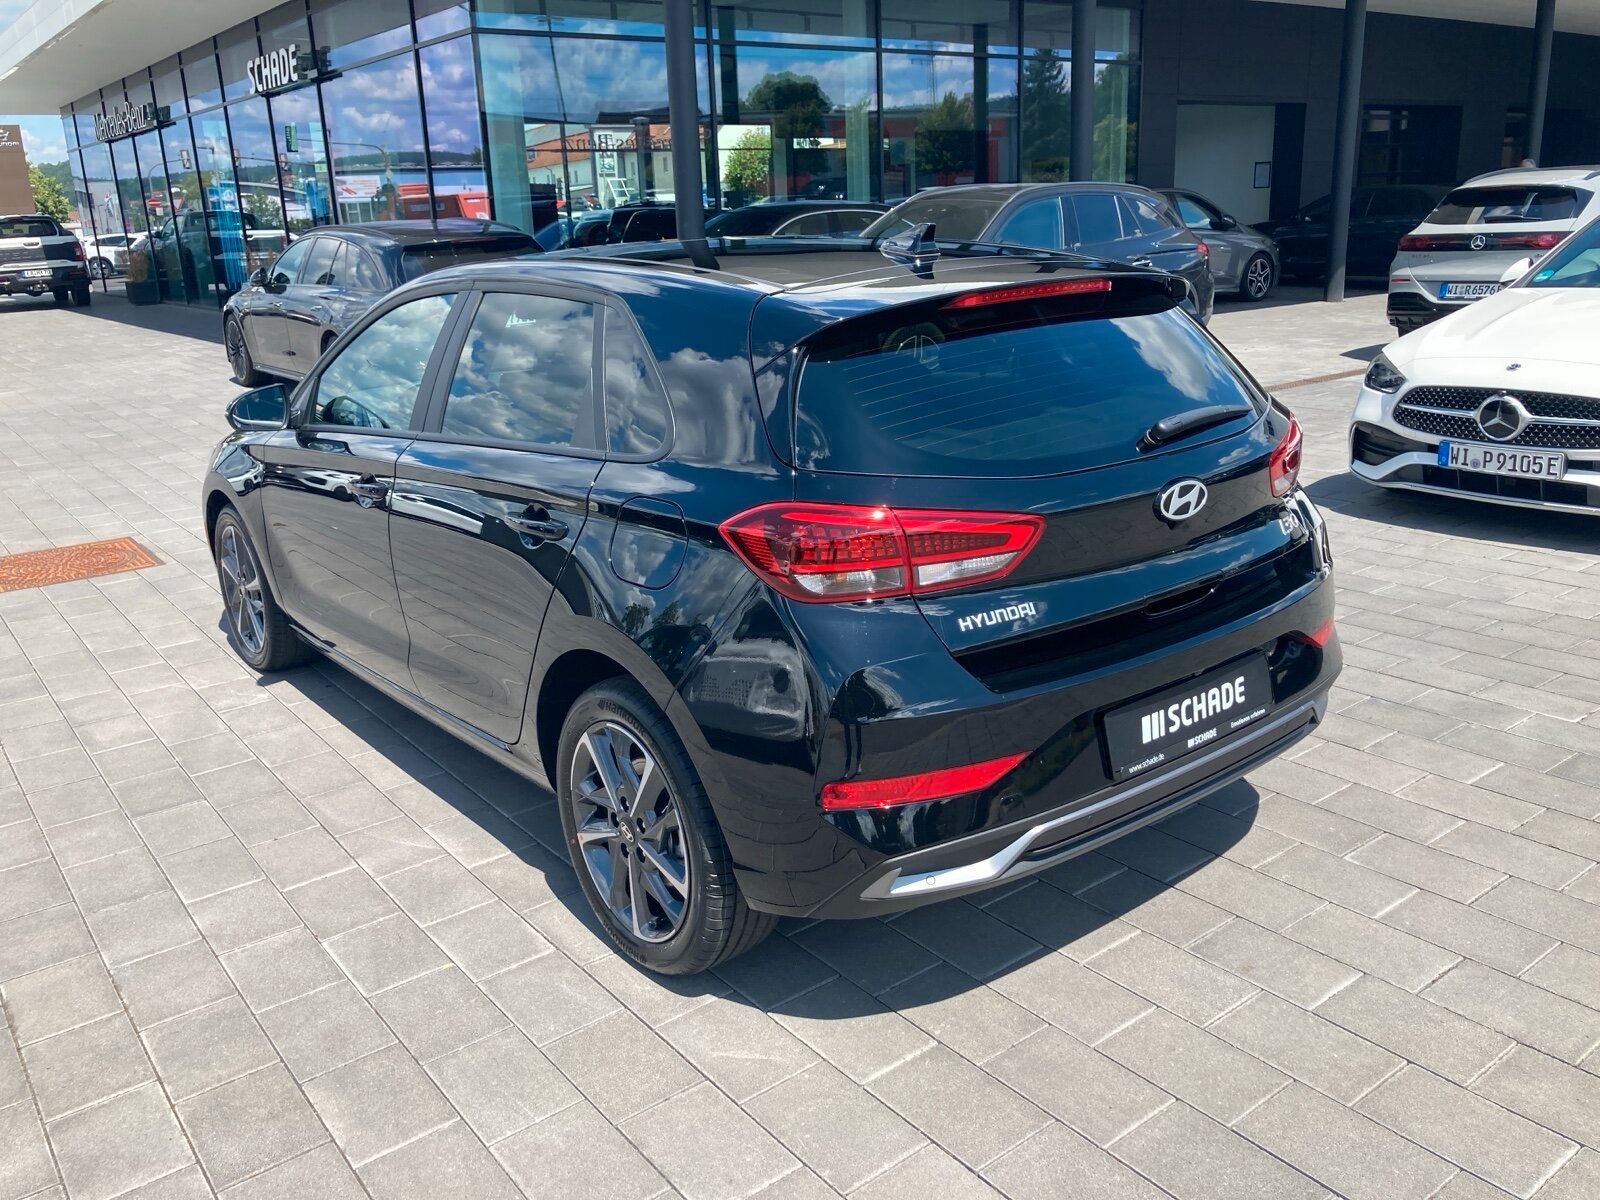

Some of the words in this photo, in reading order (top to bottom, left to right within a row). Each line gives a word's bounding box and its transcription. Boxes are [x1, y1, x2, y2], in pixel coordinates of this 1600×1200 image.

[247, 44, 298, 94] SCHADE
[96, 101, 147, 140] Mercedes-Benz
[1447, 284, 1458, 295] WI
[1450, 446, 1469, 466] WI
[1482, 451, 1559, 476] P9105E
[958, 602, 1036, 631] HYUNDAI
[1167, 676, 1245, 733] SCHADE
[1194, 728, 1217, 745] SCHADE
[1128, 753, 1165, 774] www.schade.de
